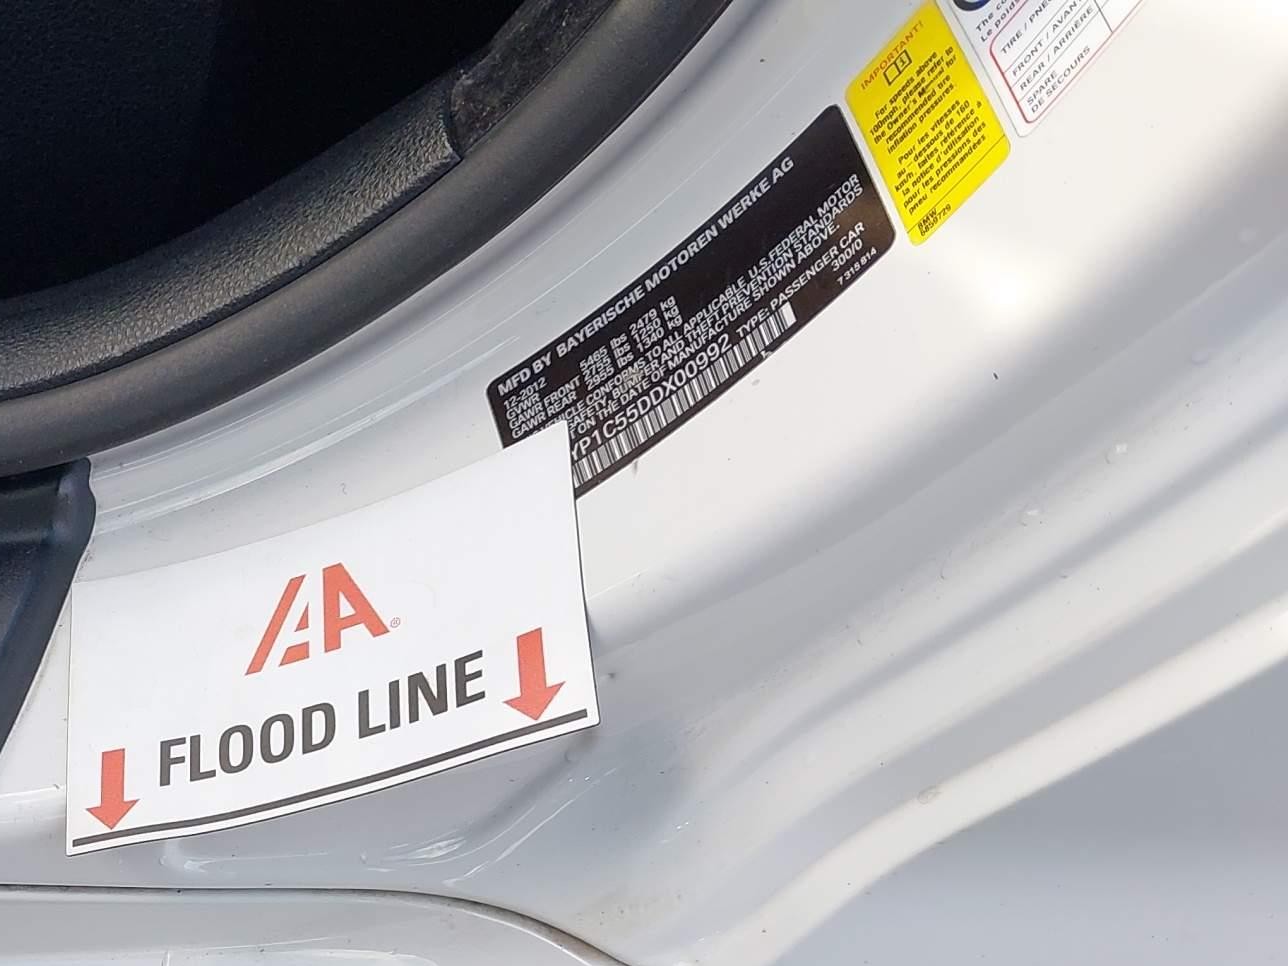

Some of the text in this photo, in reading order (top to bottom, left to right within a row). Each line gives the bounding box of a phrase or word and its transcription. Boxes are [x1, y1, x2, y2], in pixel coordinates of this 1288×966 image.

[860, 20, 925, 90] IMPORTANT!
[976, 12, 994, 32] The
[981, 28, 993, 42] Le
[1001, 30, 1022, 54] TIRE
[1029, 0, 1053, 23] PNE
[1012, 38, 1044, 76] FRONT
[1052, 0, 1082, 33] AVAN
[873, 130, 886, 144] the
[886, 98, 917, 130] Owner's
[945, 55, 956, 68] for
[875, 52, 938, 119] For speeds above
[885, 75, 951, 144] recommended tire
[902, 77, 926, 104] please
[927, 56, 945, 76] refer
[945, 46, 954, 56] to
[1020, 63, 1046, 91] REAR
[1027, 70, 1058, 105] SPARE
[1030, 46, 1091, 114] DE SECOURS
[887, 122, 918, 154] inflation
[897, 168, 906, 179] au
[913, 130, 943, 162] dessous
[944, 118, 954, 130] de
[956, 100, 970, 117] 160
[898, 100, 960, 164] Pour les vitesses
[902, 116, 980, 196] la notice d'utilisation
[903, 121, 986, 208] pour les pressions des
[917, 147, 940, 169] faites
[908, 194, 928, 215] pneu
[917, 208, 937, 230] BMW
[497, 156, 795, 396] MFD BY BAYERISCHE MOTOREN WERKE AG
[735, 307, 770, 338] TYPE:
[770, 246, 840, 311] PASSENGER
[839, 222, 865, 249] CAR
[831, 238, 863, 272] 300/0
[540, 399, 586, 432] HICLE
[586, 358, 646, 406] CONFORMS
[644, 345, 662, 360] TO
[662, 331, 683, 352] ALL
[683, 276, 747, 335] APPLICABLE
[817, 174, 860, 217] MOTOR
[612, 359, 660, 400] BUMPER
[660, 340, 685, 364] AND
[685, 309, 721, 342] THEFT
[721, 250, 793, 315] PREVENTION
[793, 183, 863, 252] STANDARDS
[506, 296, 676, 420] GVWR 5465 lbs 2479 kg
[577, 220, 840, 434] ON THE DATE OF MANUFACTURE SHOWN ABOVE.
[503, 377, 548, 410] 12-2012
[509, 305, 679, 429] GAWR FRONT 2755 lbs 1250 kg
[512, 411, 547, 439] GAWR
[547, 390, 577, 417] REAR
[585, 365, 615, 391] 2955
[616, 352, 635, 368] lbs
[637, 327, 665, 353] 1340
[666, 314, 683, 330] kg
[158, 650, 486, 787] FLOOD LINE
